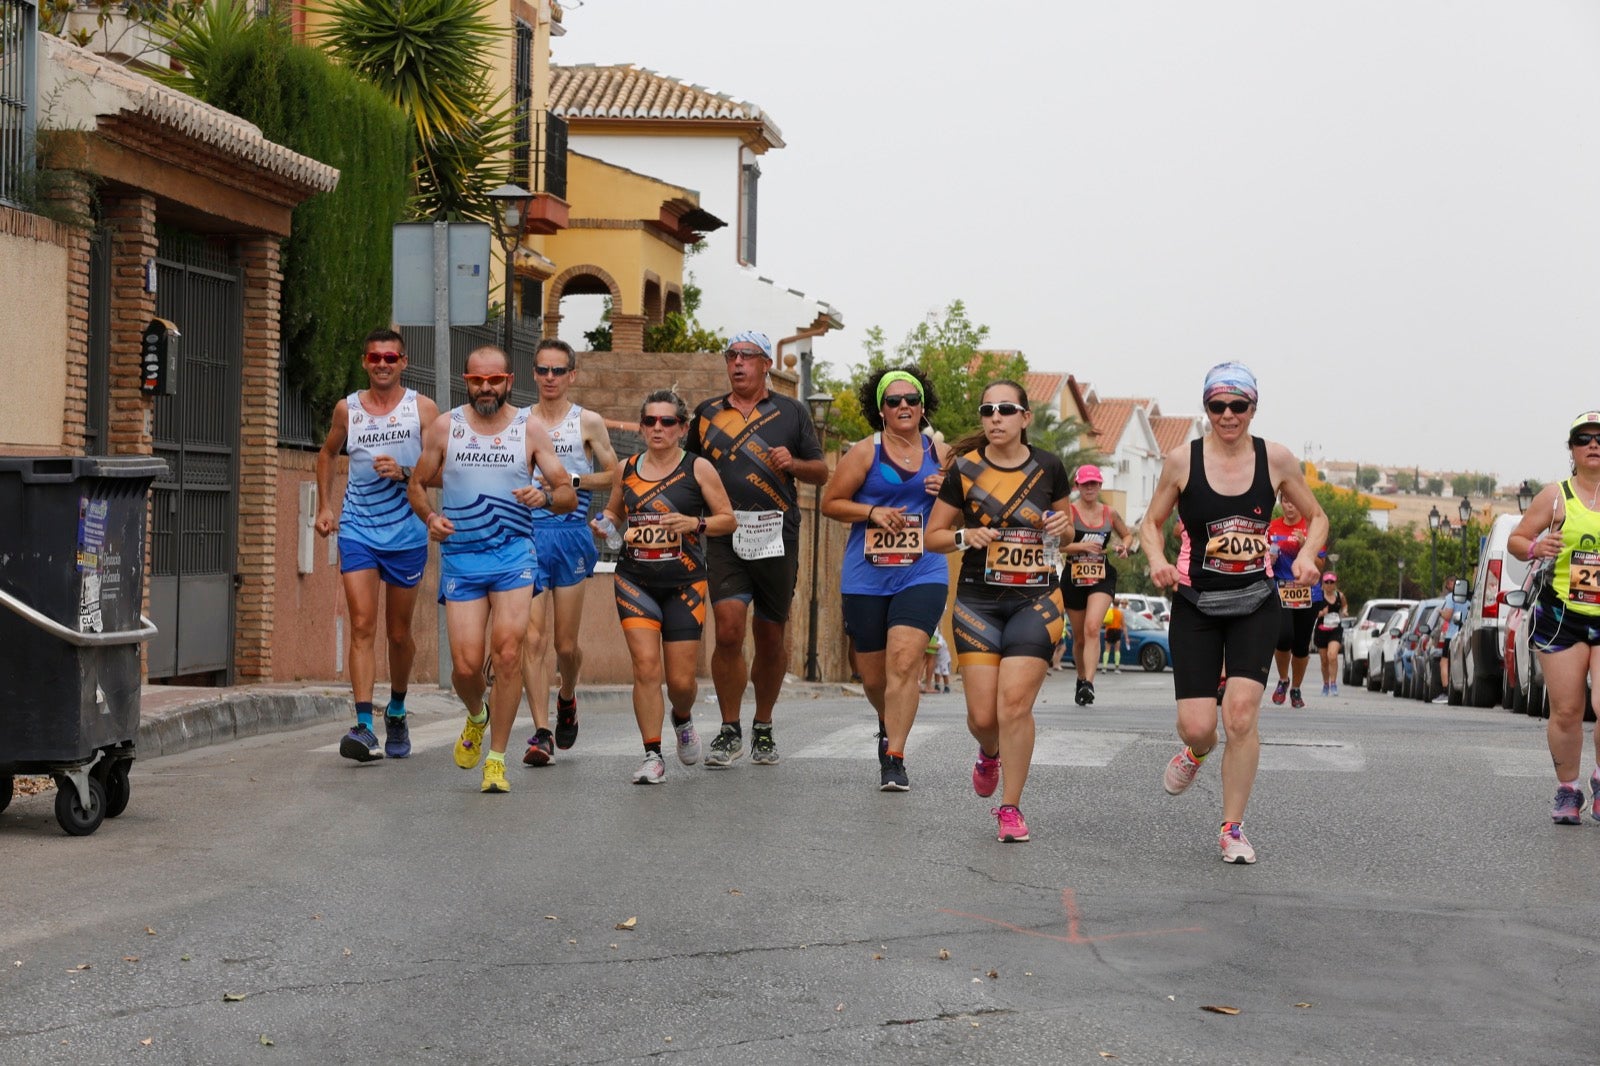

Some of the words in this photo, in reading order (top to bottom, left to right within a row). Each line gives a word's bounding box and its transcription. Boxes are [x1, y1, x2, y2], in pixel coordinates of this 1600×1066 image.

[357, 429, 411, 444] MARACENA
[455, 452, 515, 463] MARACENA
[745, 473, 789, 512] RUNNING
[873, 531, 920, 549] 2023
[1216, 536, 1266, 555] 2040
[996, 547, 1044, 567] 2056
[1076, 565, 1103, 576] 2057
[1283, 588, 1310, 600] 2002
